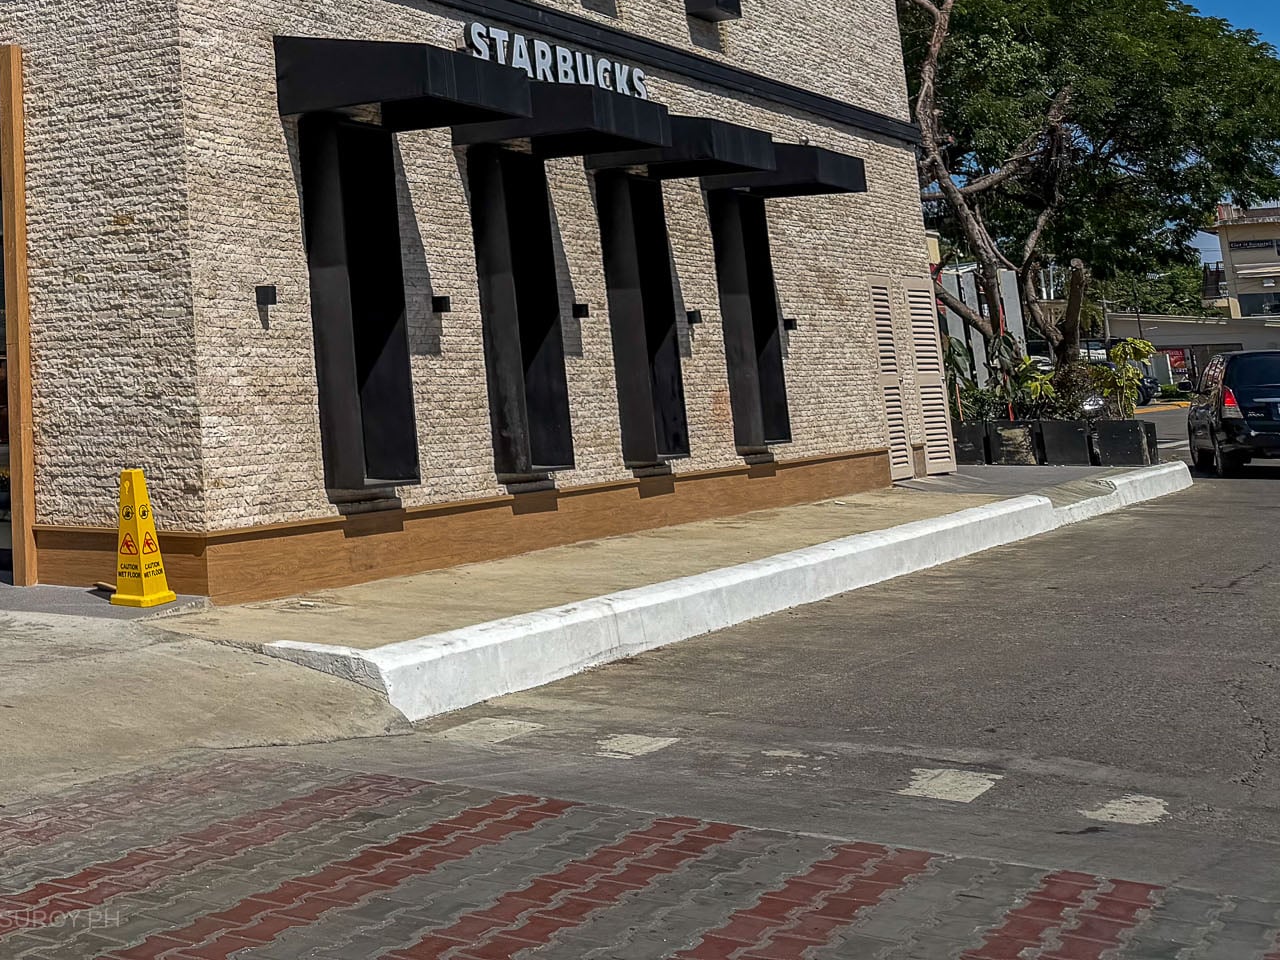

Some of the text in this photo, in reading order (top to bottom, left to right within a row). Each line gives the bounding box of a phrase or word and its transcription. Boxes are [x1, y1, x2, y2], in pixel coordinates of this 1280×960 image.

[470, 22, 648, 100] STARBUCKS
[145, 561, 160, 570] CAUTION
[151, 568, 163, 576] FLOOR
